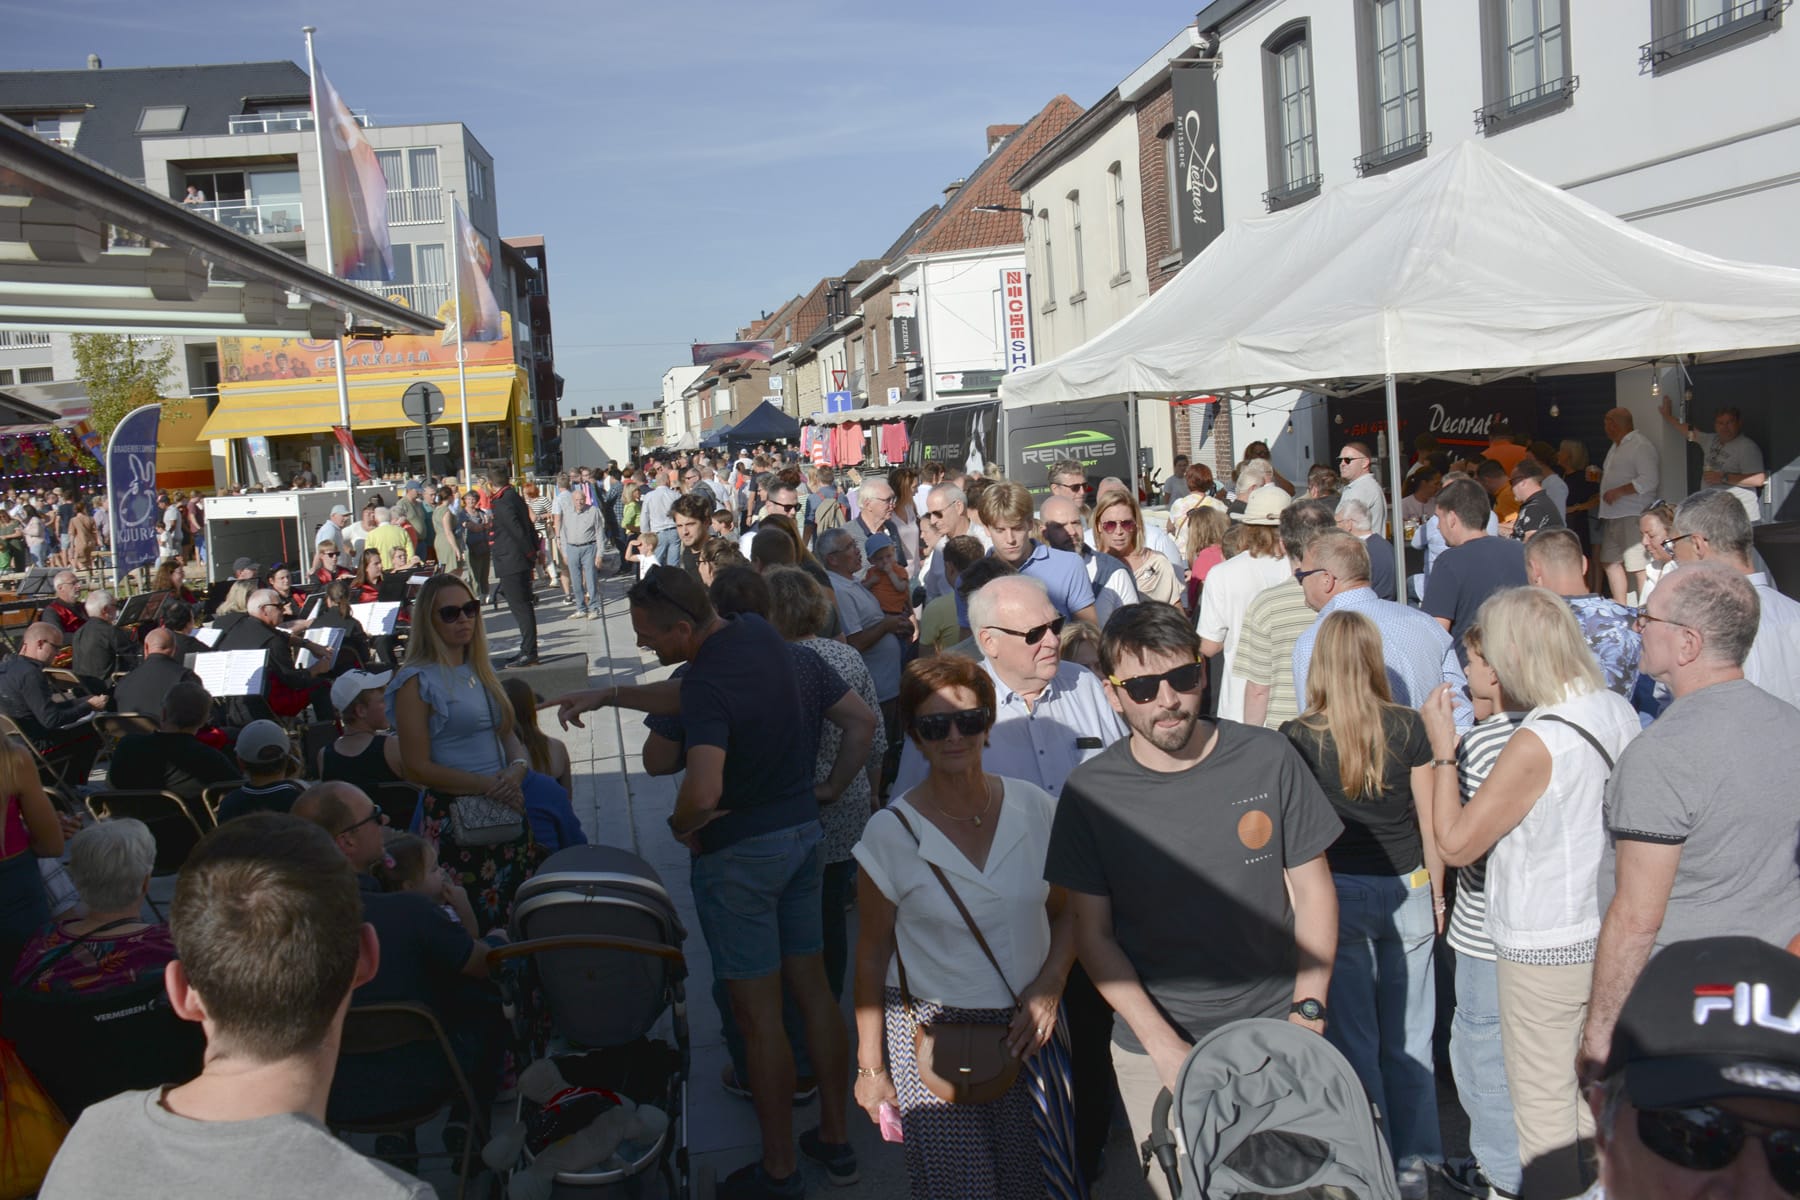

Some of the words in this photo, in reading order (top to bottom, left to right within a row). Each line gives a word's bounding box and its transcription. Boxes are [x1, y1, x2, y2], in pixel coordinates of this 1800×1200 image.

[1177, 116, 1186, 168] PATISSERIE
[901, 319, 910, 351] PIZZERIA
[315, 351, 431, 370] GEAKKRAAM
[1429, 403, 1509, 435] Decorat
[1022, 442, 1117, 465] RENTIES
[94, 1004, 147, 1022] VERMEIREN
